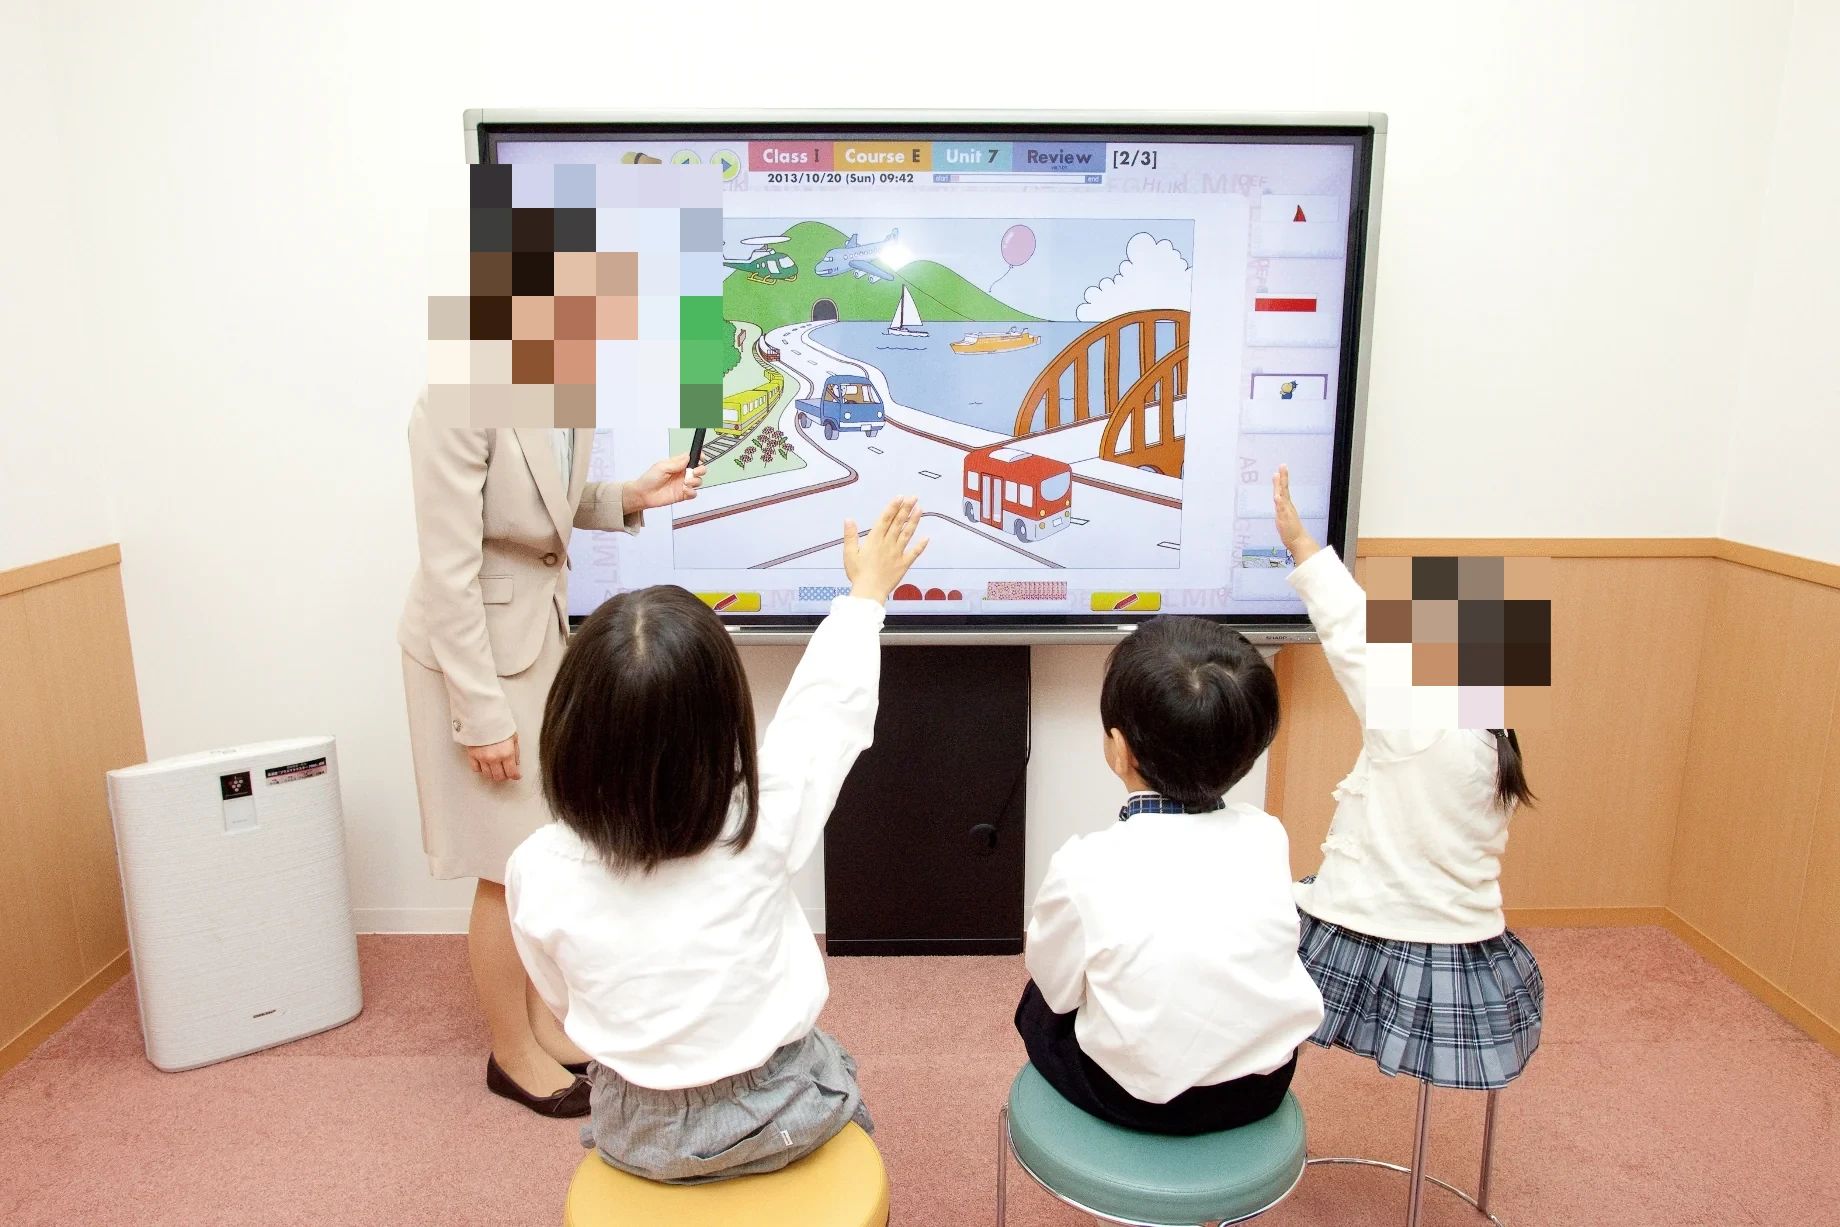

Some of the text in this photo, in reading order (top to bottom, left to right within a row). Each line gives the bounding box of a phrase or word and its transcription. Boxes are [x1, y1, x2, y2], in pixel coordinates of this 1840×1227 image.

[762, 148, 808, 164] Class
[845, 148, 921, 164] Course E
[946, 149, 999, 164] Unit 7
[1027, 149, 1092, 164] Review
[1113, 150, 1157, 169] [2/3]
[768, 173, 914, 185] 2013/10/20 (Sun) 09:42
